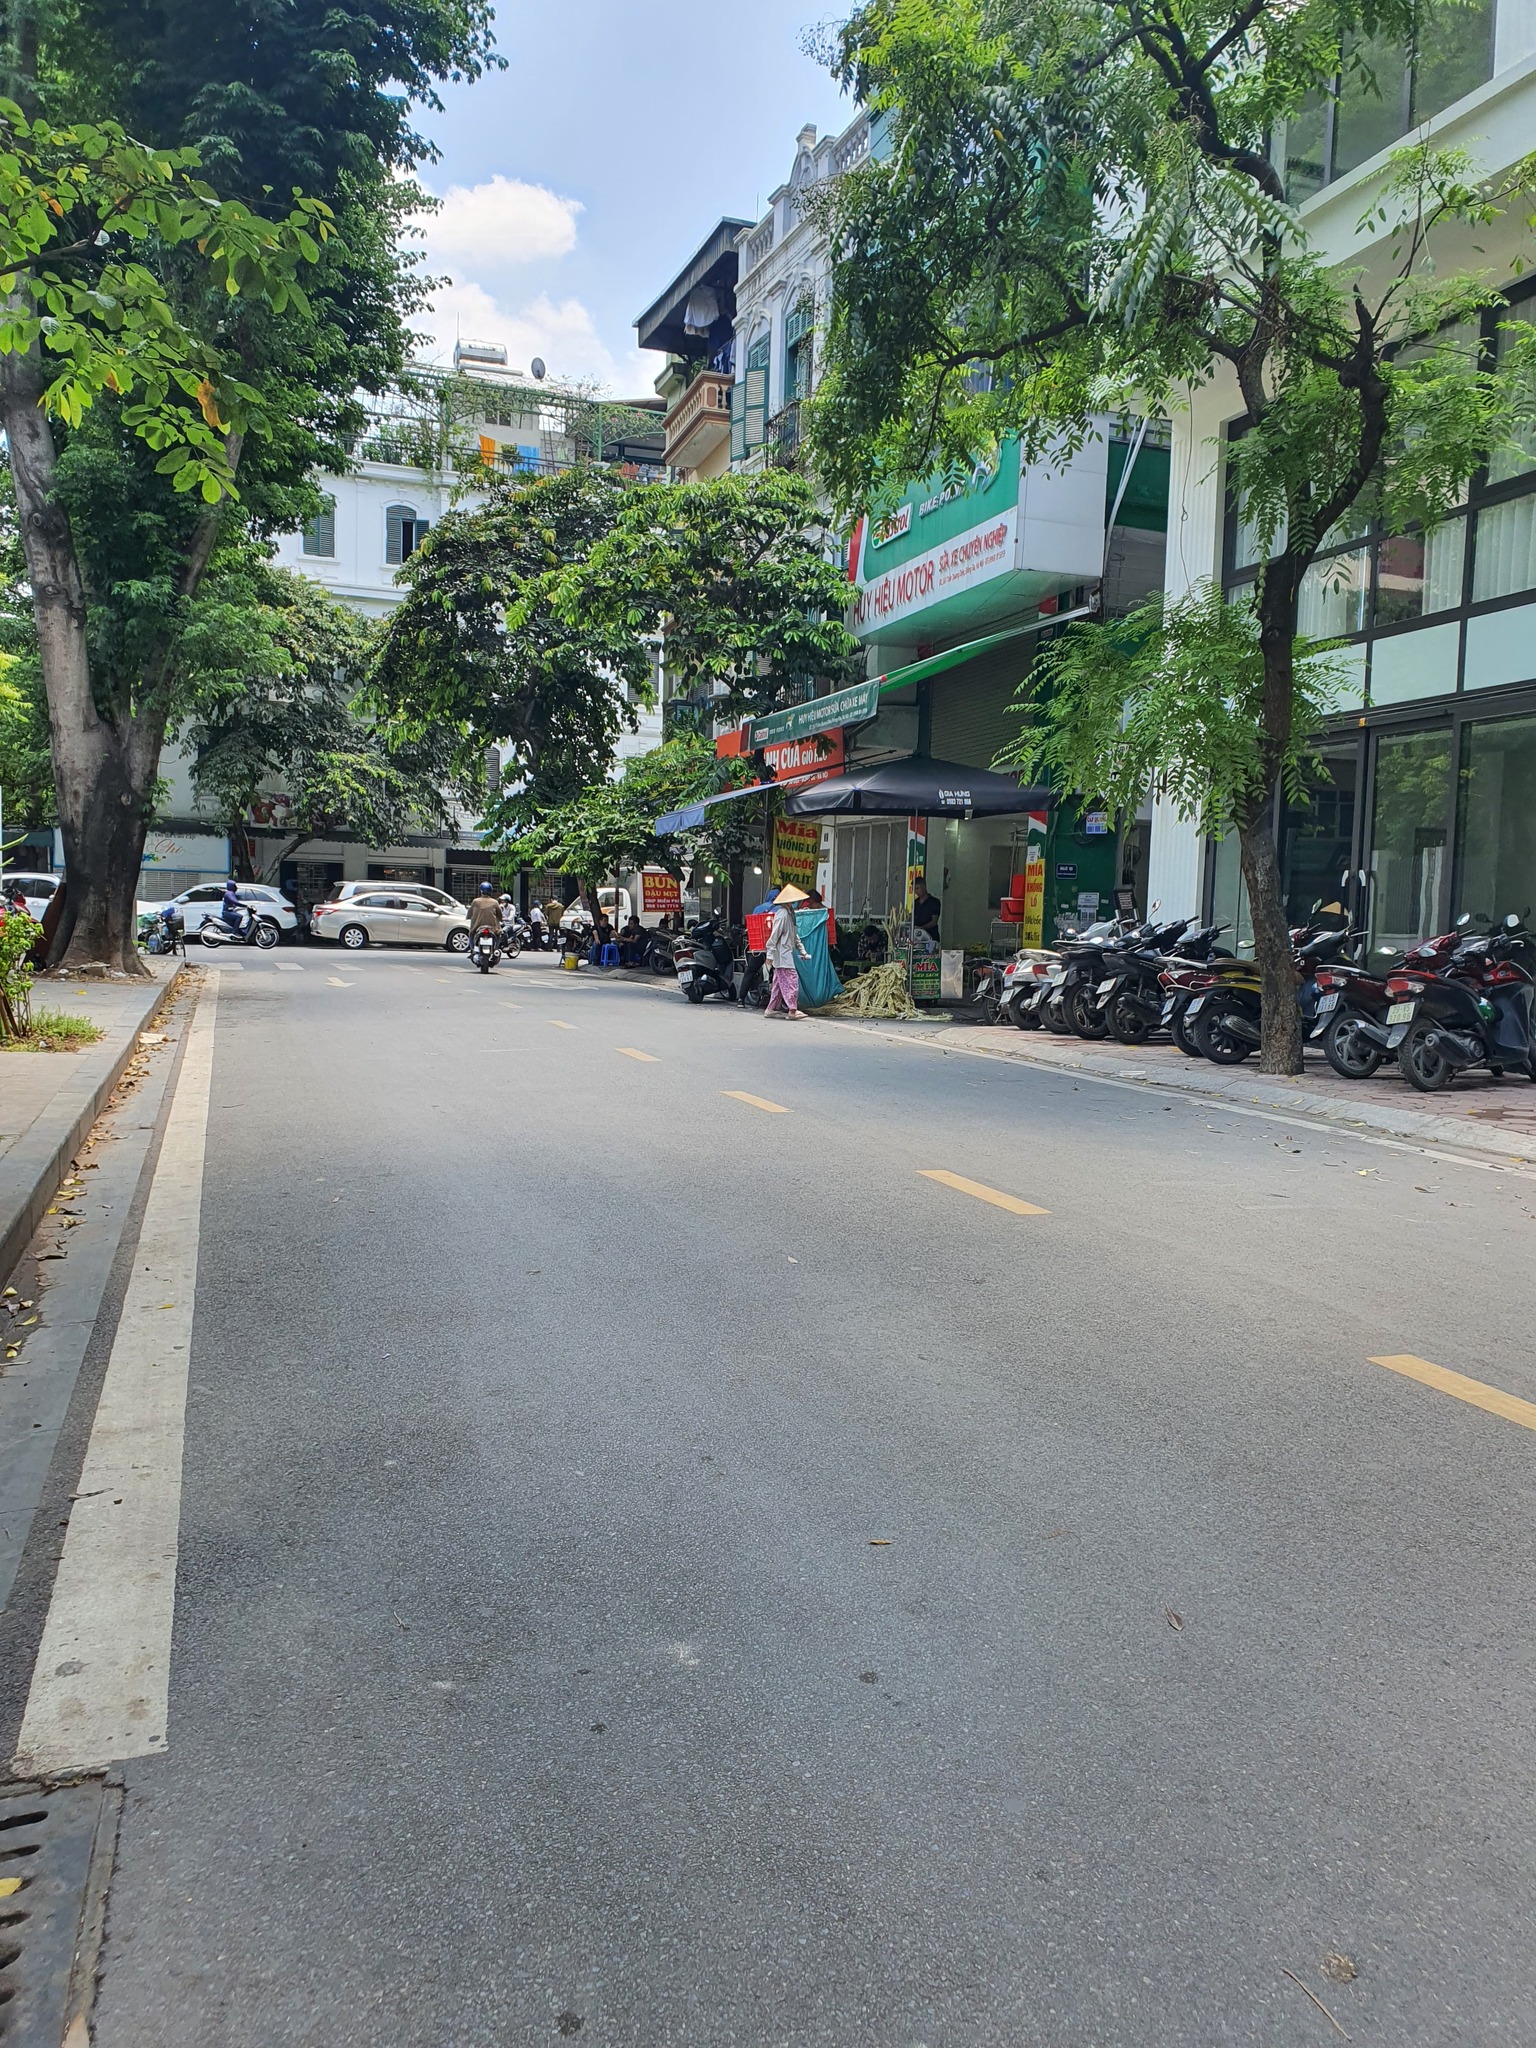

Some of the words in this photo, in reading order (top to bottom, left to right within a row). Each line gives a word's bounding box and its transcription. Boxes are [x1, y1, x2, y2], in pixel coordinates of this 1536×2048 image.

[919, 495, 938, 517] BIKE
[854, 591, 872, 626] HUY
[874, 577, 895, 618] HIỆU
[897, 560, 935, 606] MOTOR
[781, 745, 800, 770] CUA
[776, 820, 818, 838] Mía
[1027, 861, 1043, 876] MÍA
[643, 874, 678, 888] BÚN
